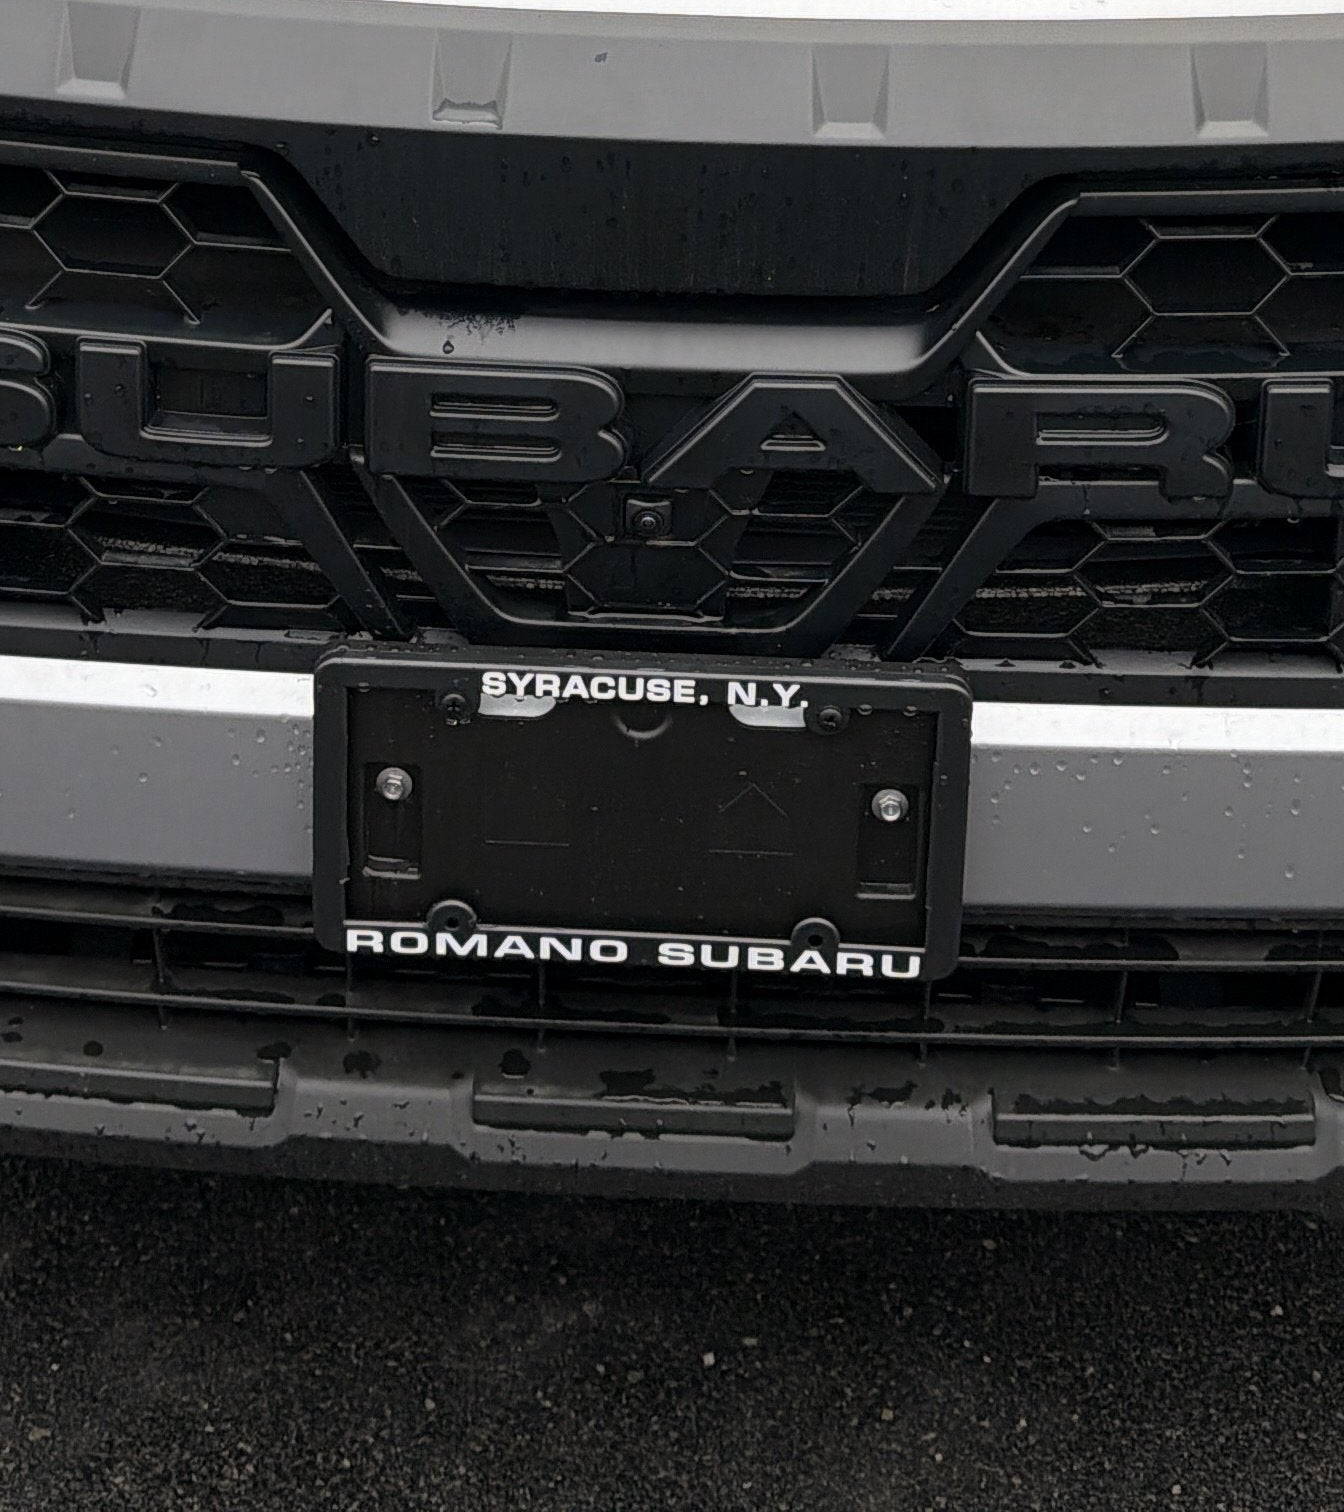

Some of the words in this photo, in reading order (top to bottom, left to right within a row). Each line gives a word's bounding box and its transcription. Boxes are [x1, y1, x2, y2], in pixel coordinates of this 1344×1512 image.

[481, 671, 709, 707] SYRACUSE,
[727, 682, 810, 709] N.Y.
[345, 929, 629, 964] ROMANO
[657, 941, 921, 979] SUBARU
